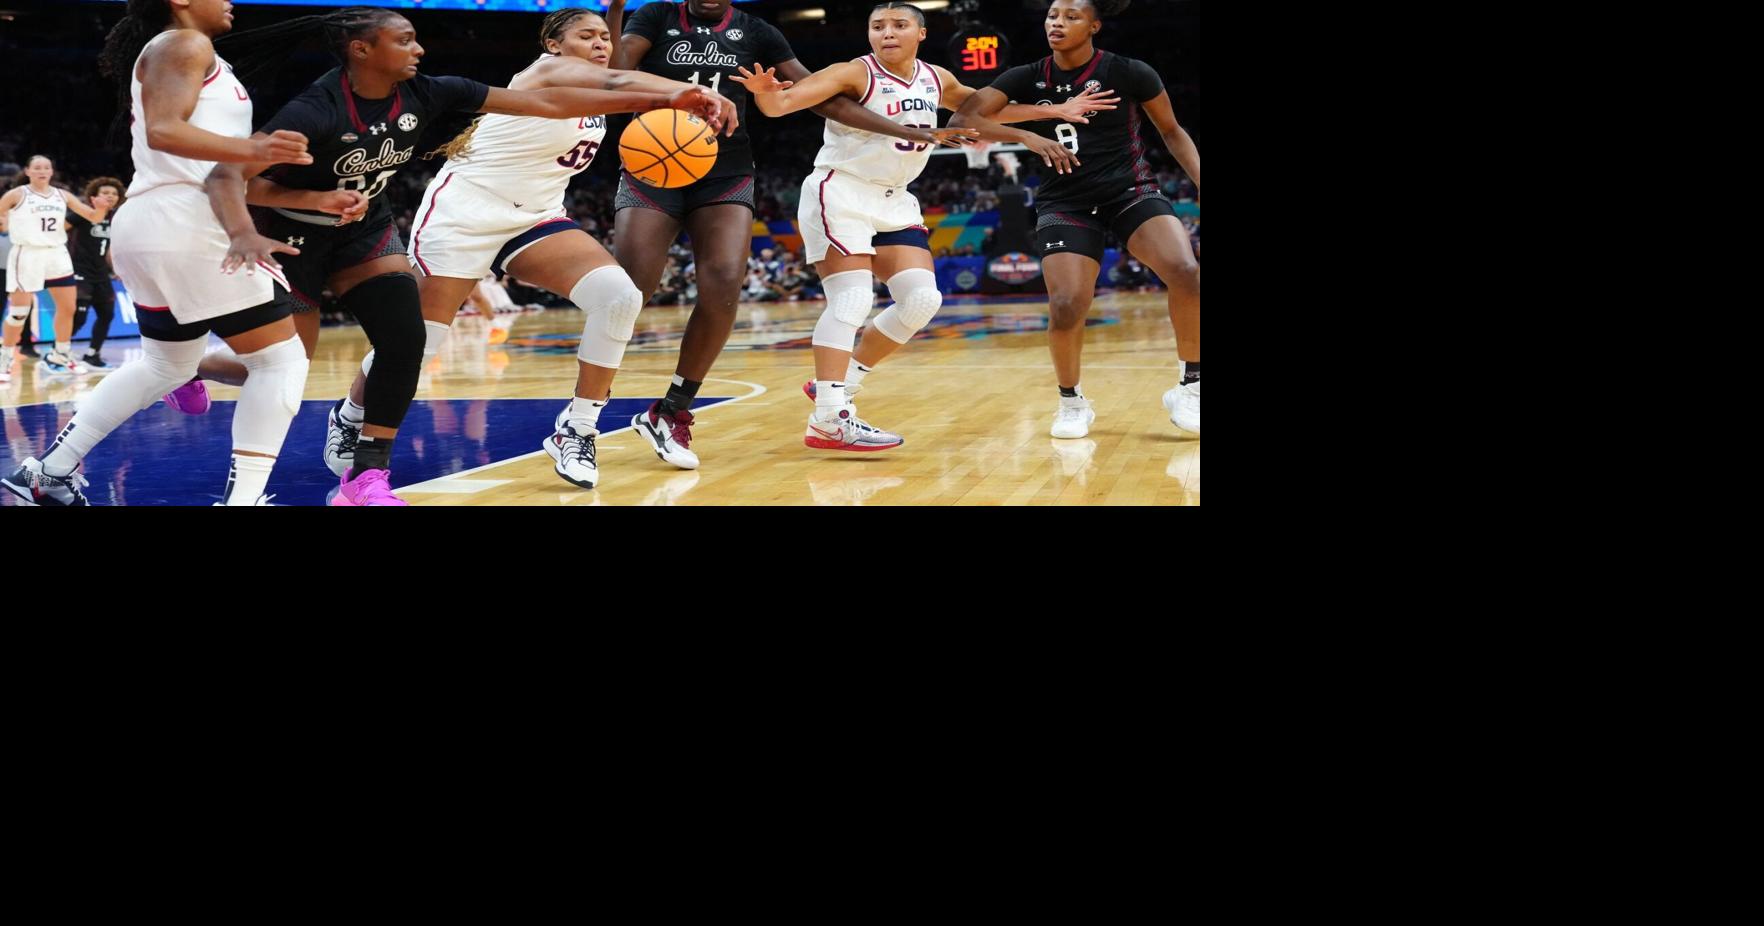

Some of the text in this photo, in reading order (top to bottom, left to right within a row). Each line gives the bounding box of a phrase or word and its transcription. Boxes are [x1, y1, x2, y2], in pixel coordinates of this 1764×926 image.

[727, 29, 743, 40] SEC
[667, 40, 738, 67] Carolina
[961, 48, 997, 70] 30
[1055, 123, 1079, 155] 8
[333, 137, 414, 176] Carolina
[556, 140, 600, 170] 55
[40, 217, 57, 232] 12
